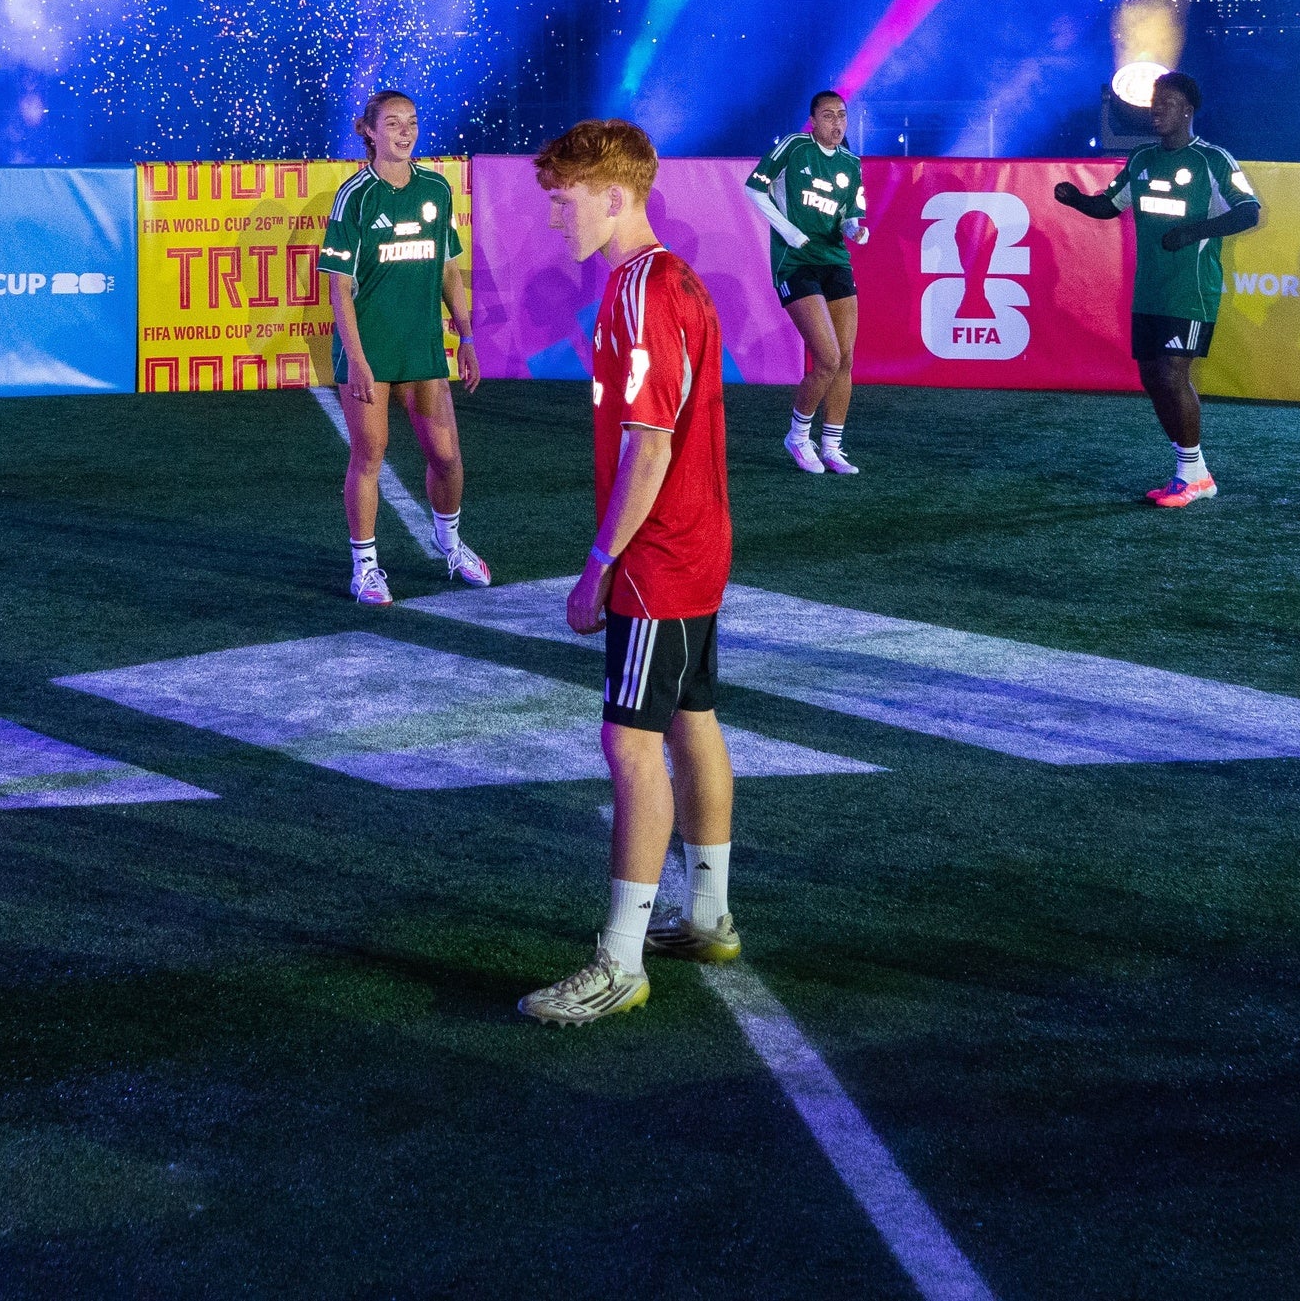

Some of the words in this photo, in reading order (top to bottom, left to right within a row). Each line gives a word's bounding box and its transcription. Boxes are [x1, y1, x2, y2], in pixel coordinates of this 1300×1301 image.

[143, 218, 170, 234] FIFA
[173, 216, 221, 234] WORLD
[224, 216, 251, 232] CUP
[288, 215, 316, 231] FIFA
[166, 244, 332, 310] TRIO
[143, 325, 171, 342] FIFA
[174, 324, 221, 341] WORLD
[225, 323, 252, 340] CUP
[288, 321, 317, 338] FIFA
[952, 327, 1002, 345] FIFA
